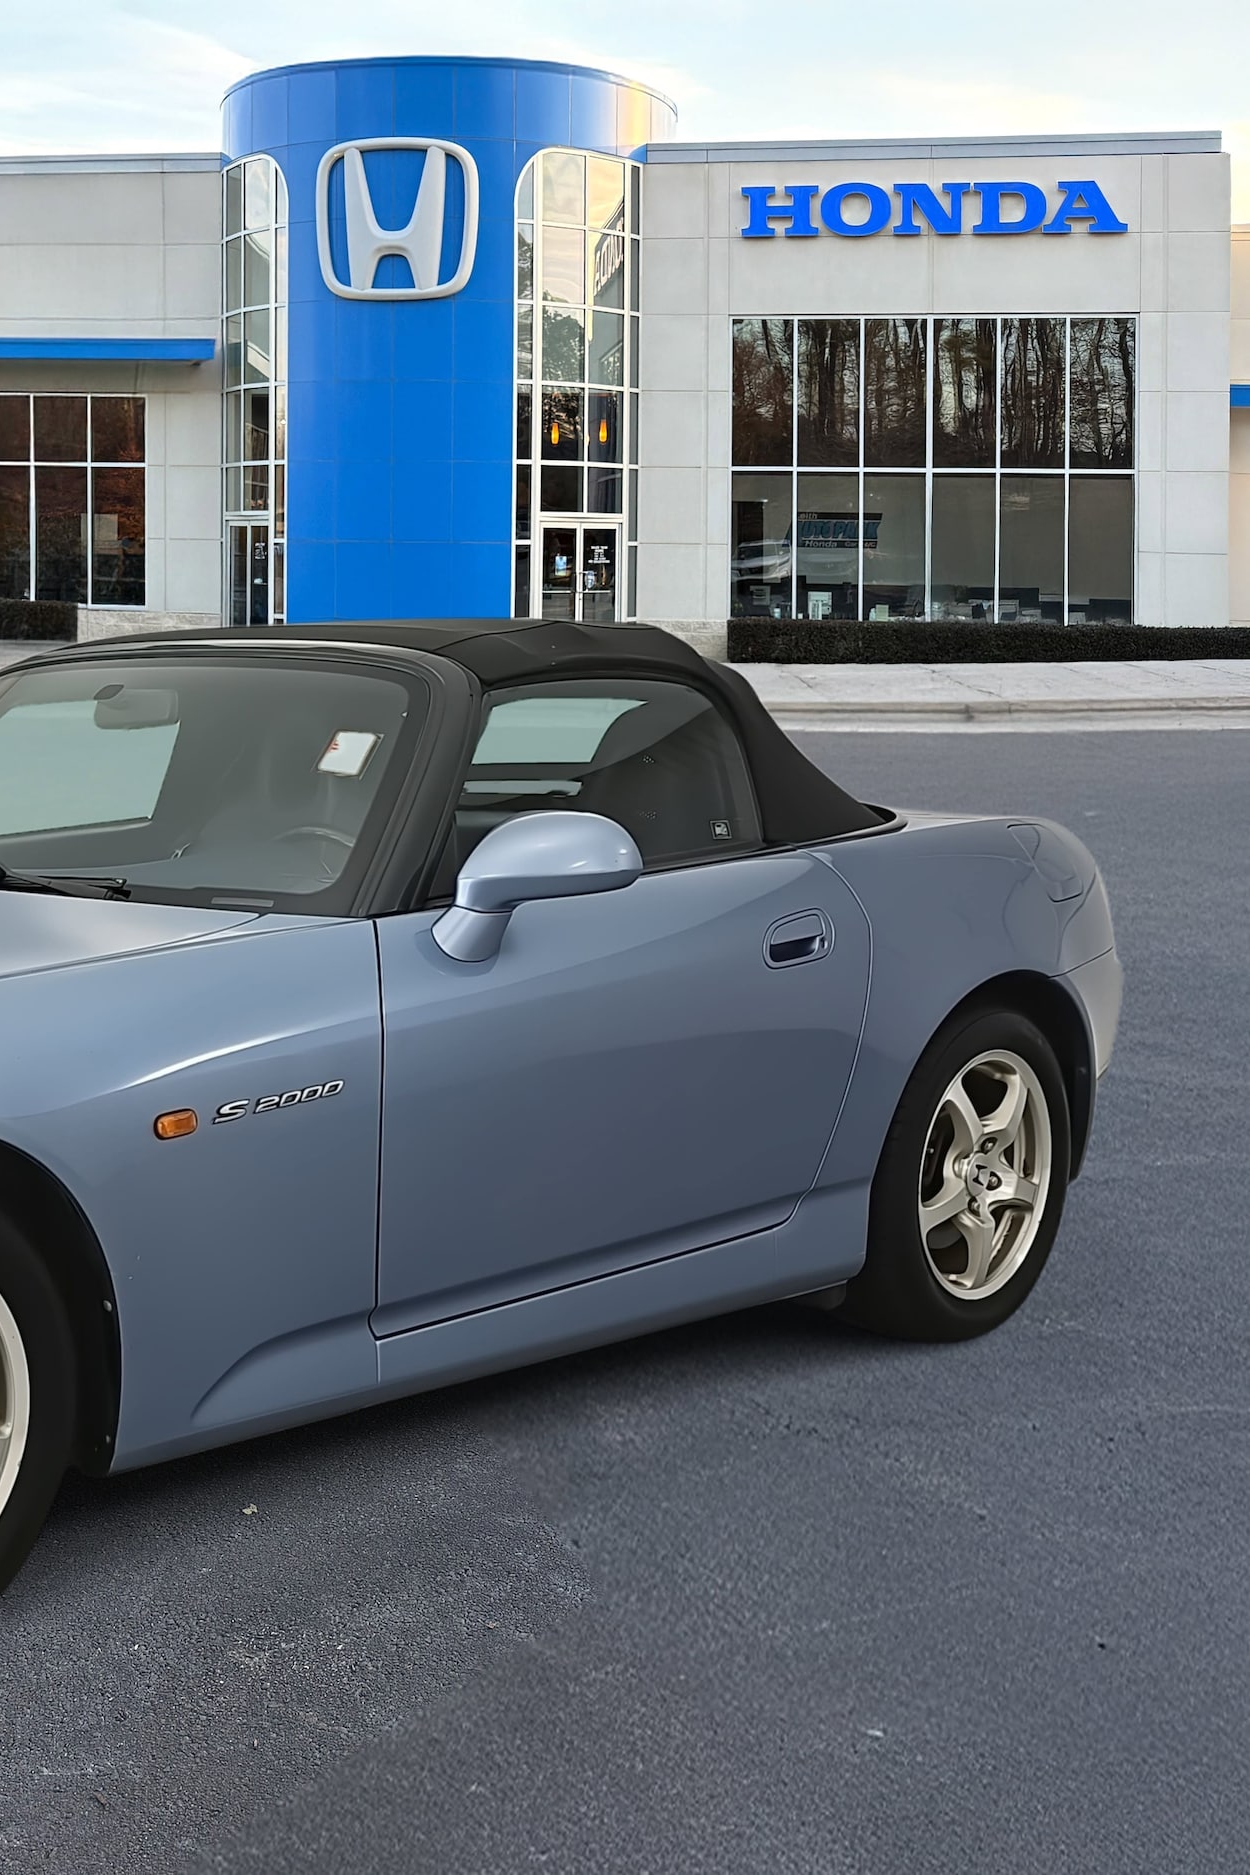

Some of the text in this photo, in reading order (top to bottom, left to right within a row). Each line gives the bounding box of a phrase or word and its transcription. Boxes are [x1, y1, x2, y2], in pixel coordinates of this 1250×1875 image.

[741, 180, 1128, 237] HONDA
[805, 540, 838, 548] Honda
[213, 1078, 345, 1124] S 2000
